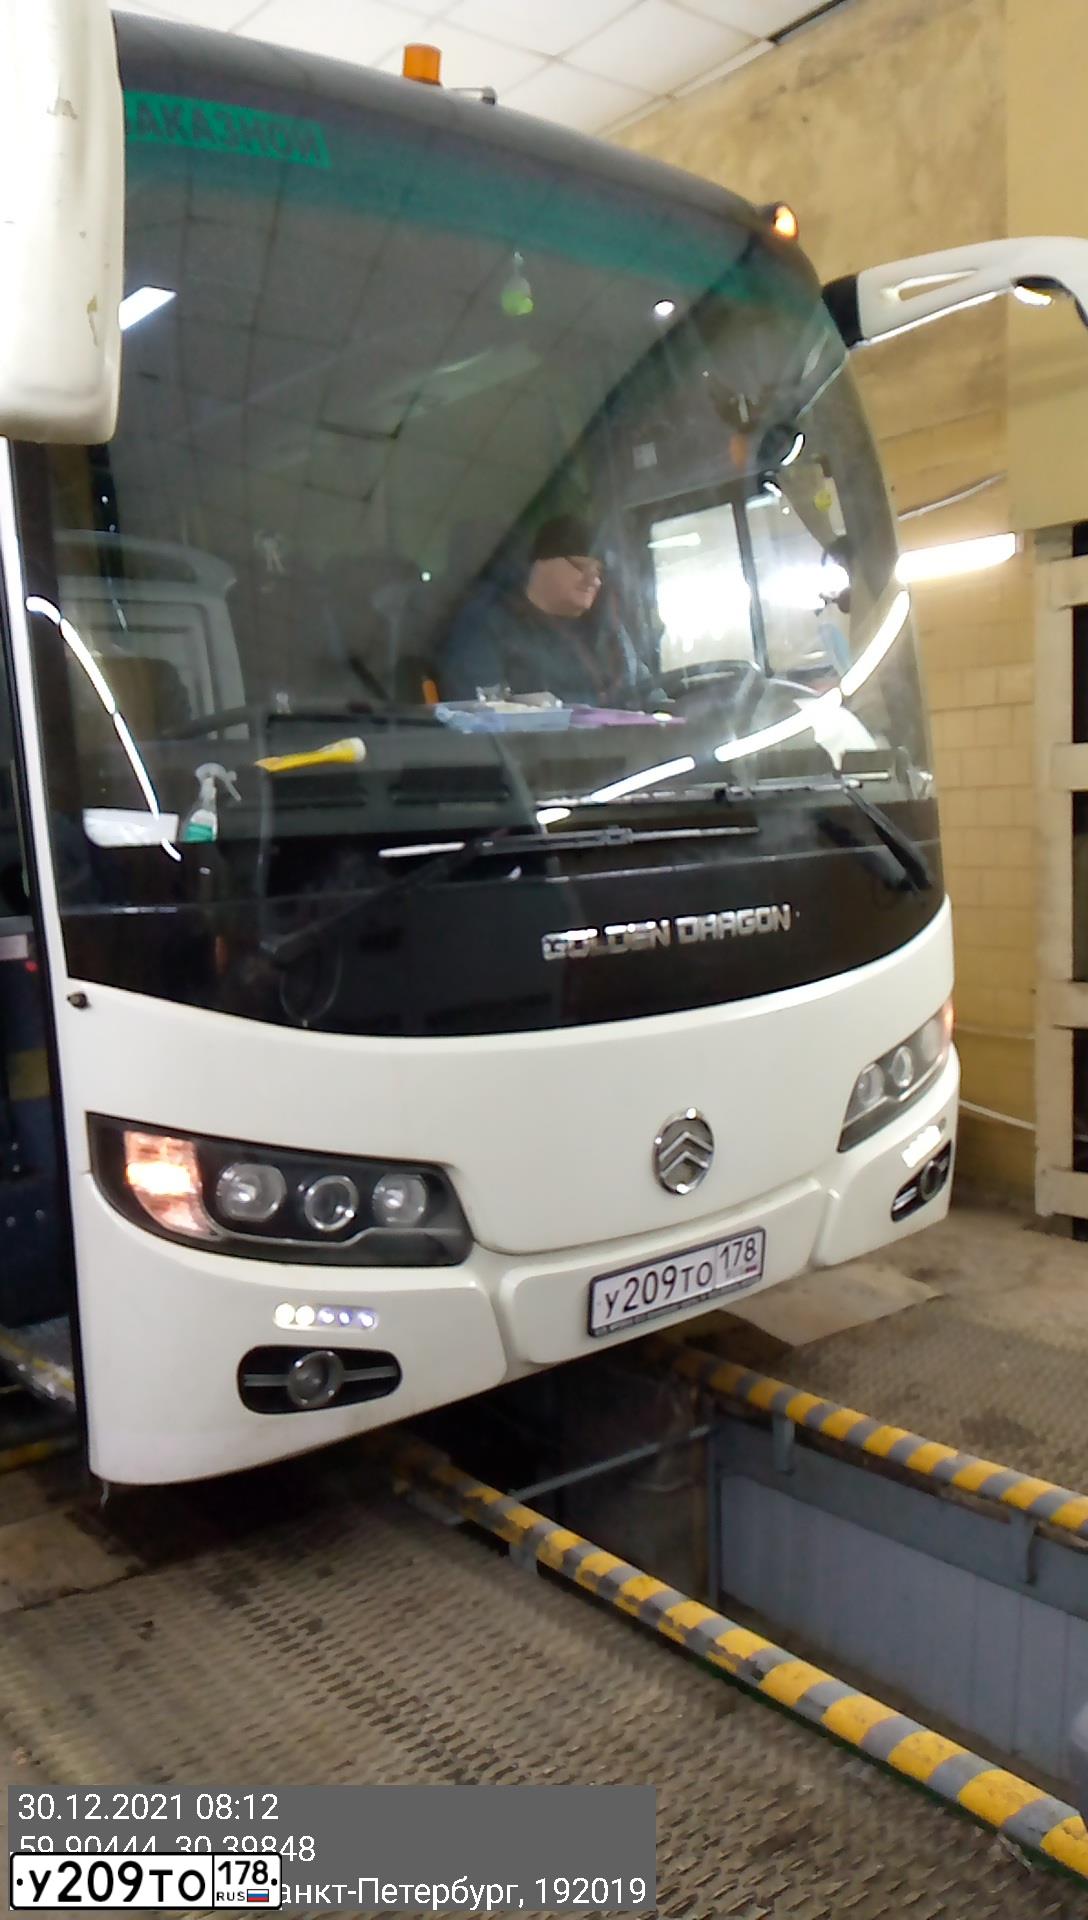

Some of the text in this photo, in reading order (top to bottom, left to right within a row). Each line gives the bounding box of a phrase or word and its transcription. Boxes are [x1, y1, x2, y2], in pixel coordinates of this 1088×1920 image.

[126, 100, 326, 163] АКАЗНОЙ
[541, 904, 791, 961] GOLDEN DRAGON
[719, 1237, 757, 1270] 178
